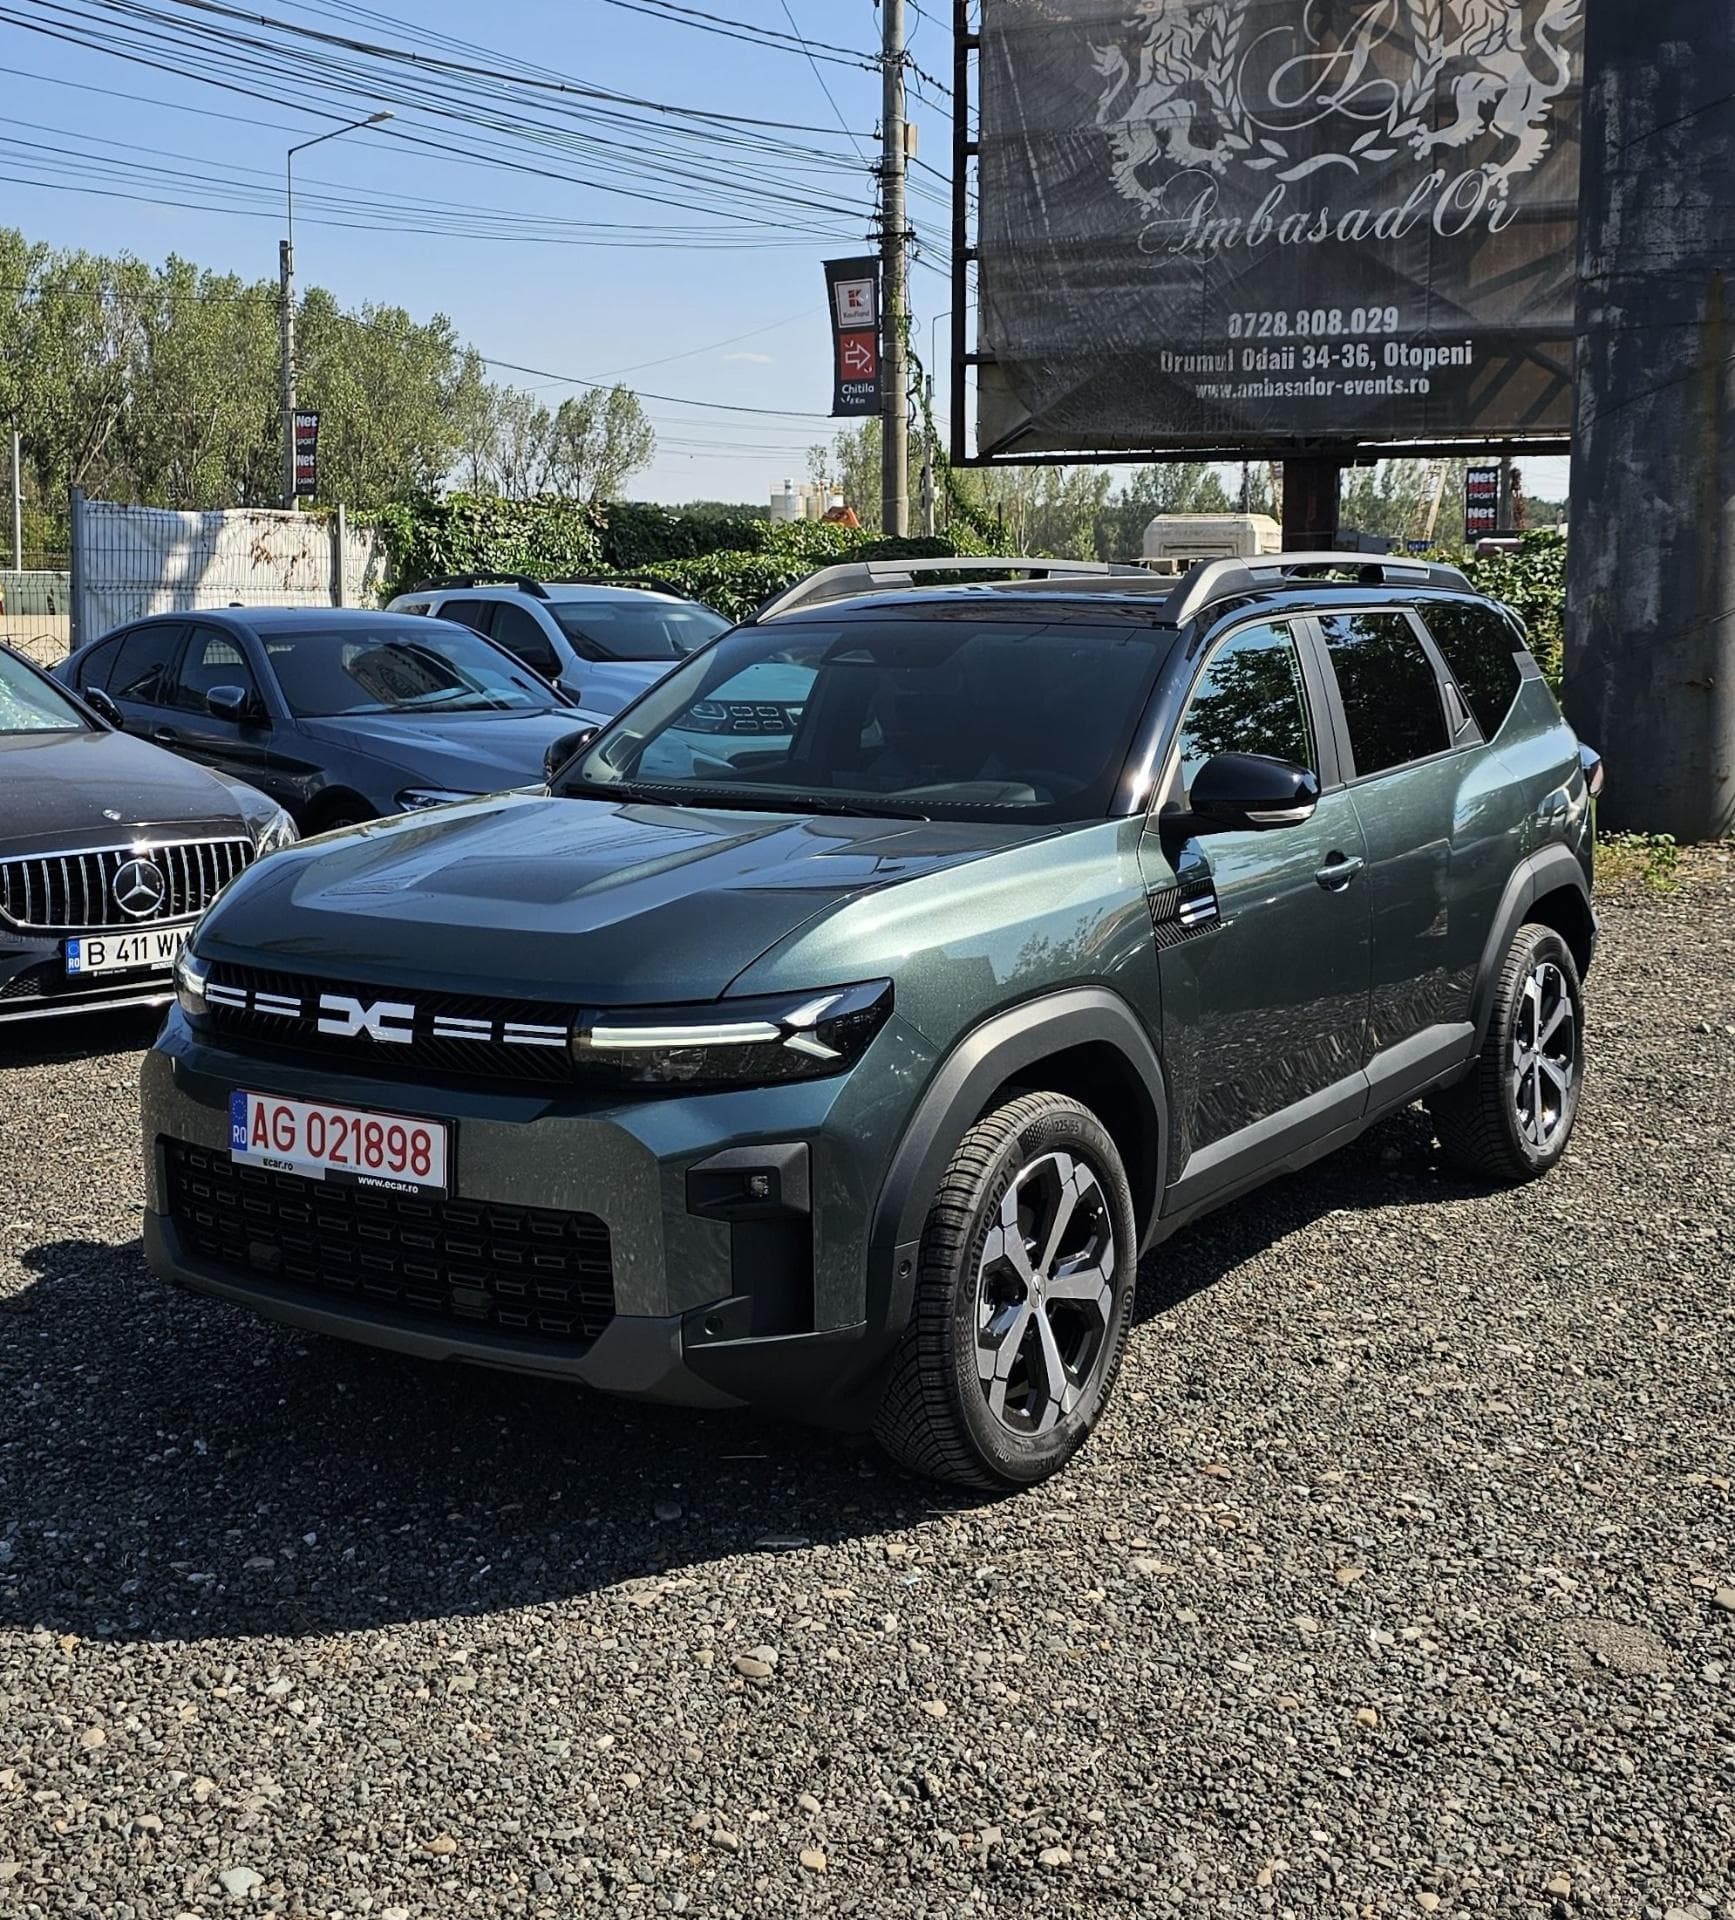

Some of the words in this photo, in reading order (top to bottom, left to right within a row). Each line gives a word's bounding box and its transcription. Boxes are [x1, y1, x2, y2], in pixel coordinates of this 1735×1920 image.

[1227, 306, 1399, 340] 0728.808.029
[1160, 348, 1235, 373] Drumul
[1241, 347, 1295, 371] Odaii
[1301, 343, 1378, 372] 34-36,
[1384, 339, 1473, 370] Otopeni
[841, 383, 875, 394] Chitila
[1195, 376, 1430, 399] www.ambasador-events.ro
[296, 415, 318, 427] Net
[297, 438, 316, 446] SPORT
[296, 454, 315, 466] Net
[297, 477, 315, 485] CASINO
[1468, 472, 1496, 483] Net
[1467, 507, 1496, 518] Net
[68, 958, 80, 969] RO
[87, 941, 106, 966] B
[116, 936, 148, 962] 411
[232, 1125, 247, 1145] RO
[252, 1102, 296, 1152] AG
[306, 1111, 431, 1177] 021898
[358, 1175, 419, 1194] www.ecar.ro
